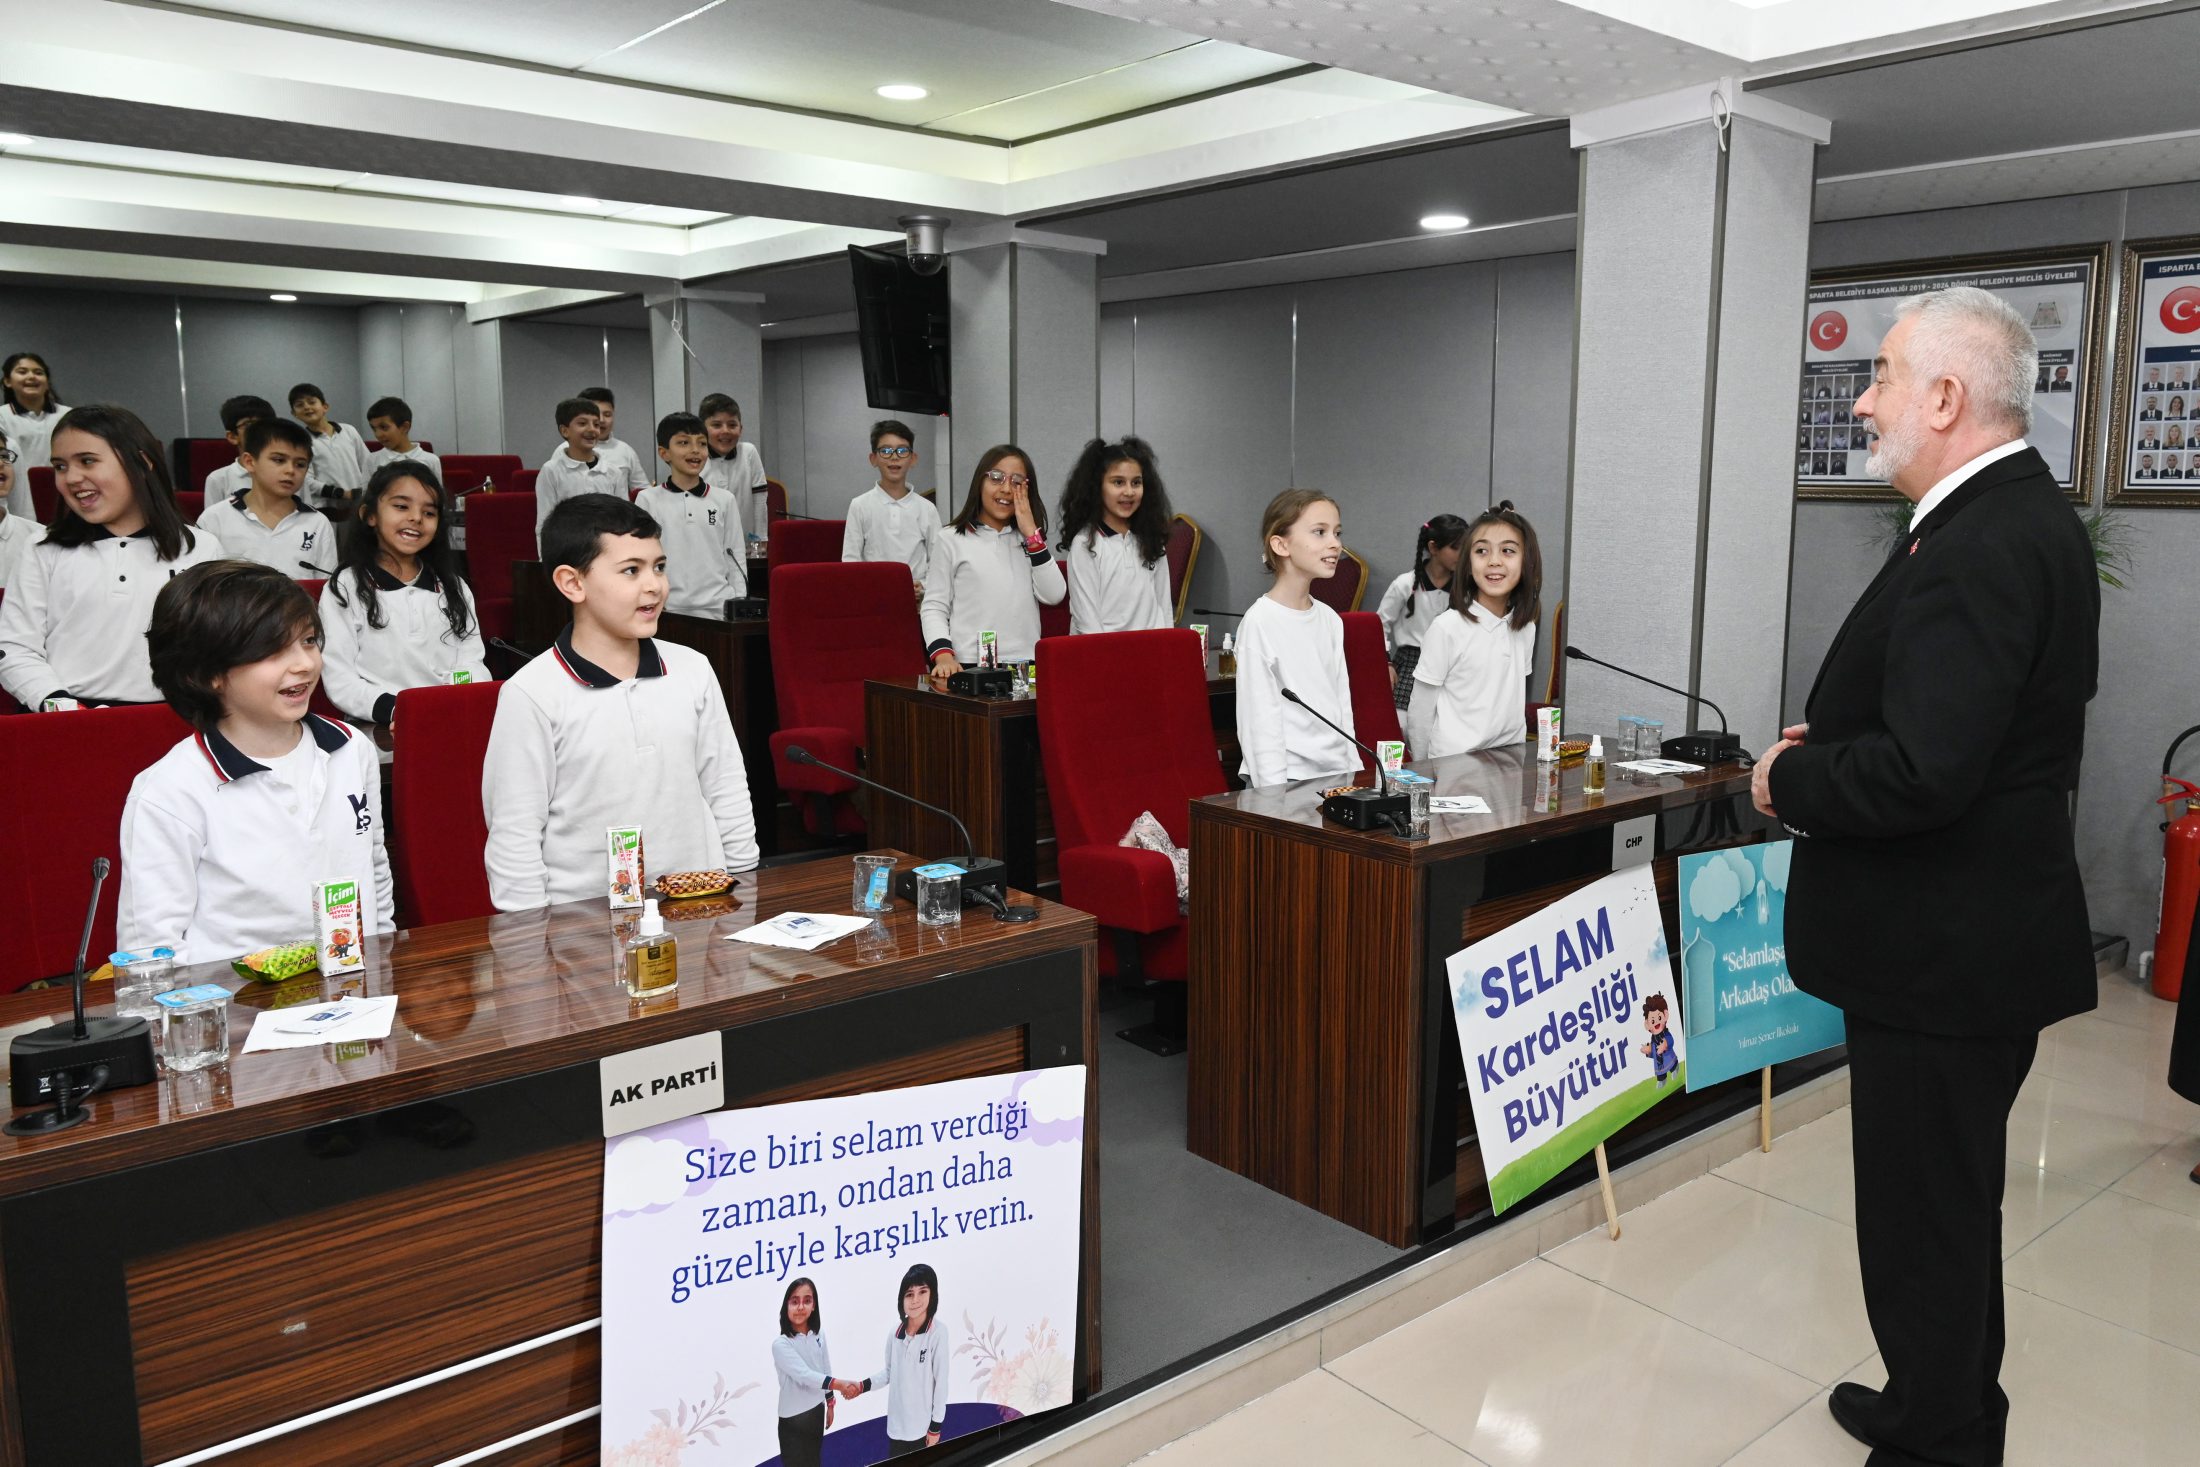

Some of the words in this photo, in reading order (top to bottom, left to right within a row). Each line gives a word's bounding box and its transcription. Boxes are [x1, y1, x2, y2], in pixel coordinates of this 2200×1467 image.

[1809, 291, 1834, 300] SPARTA
[1835, 287, 1866, 298] BELEDİYE
[1867, 285, 1908, 296] BAŞKANLIĞI
[1909, 283, 1925, 292] 2019
[1980, 275, 2013, 286] BELEDİYE
[2015, 272, 2043, 283] MECLİS
[2044, 269, 2078, 281] ÜYELERİ
[1625, 835, 1643, 849] CHP
[1480, 906, 1615, 1019] SELAM
[1719, 980, 1769, 1012] Arkadaş
[1722, 941, 1785, 972] “Selamlaşa
[1477, 962, 1639, 1094] Kardeşliği
[609, 1083, 644, 1107] AK
[651, 1061, 717, 1096] PARTİ
[1503, 1038, 1629, 1143] Büyütür
[686, 1146, 757, 1183] Size
[768, 1131, 823, 1170] biri
[832, 1120, 924, 1160] selam
[931, 1100, 1028, 1143] verdiği
[702, 1194, 827, 1233] zaman,
[838, 1165, 935, 1208] ondan
[942, 1150, 1013, 1189] daha
[671, 1231, 825, 1304] güzeliyle
[834, 1206, 949, 1260] karşılık
[955, 1196, 1033, 1234] verin.
